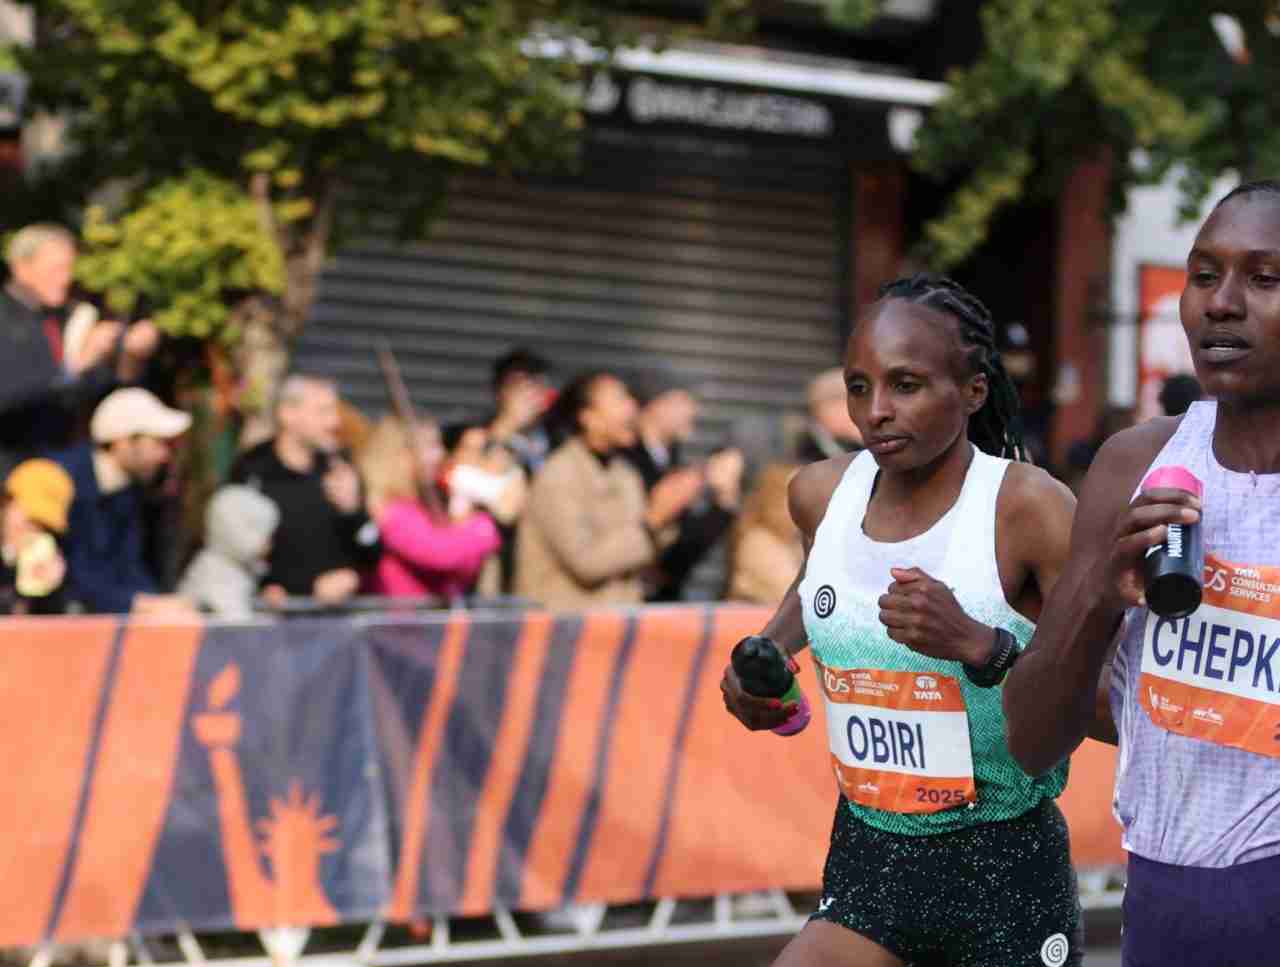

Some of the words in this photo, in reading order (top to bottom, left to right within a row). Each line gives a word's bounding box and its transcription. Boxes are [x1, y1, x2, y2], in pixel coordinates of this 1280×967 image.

[912, 690, 943, 701] TATA
[847, 715, 926, 769] OBIRI
[916, 787, 966, 804] 2025
